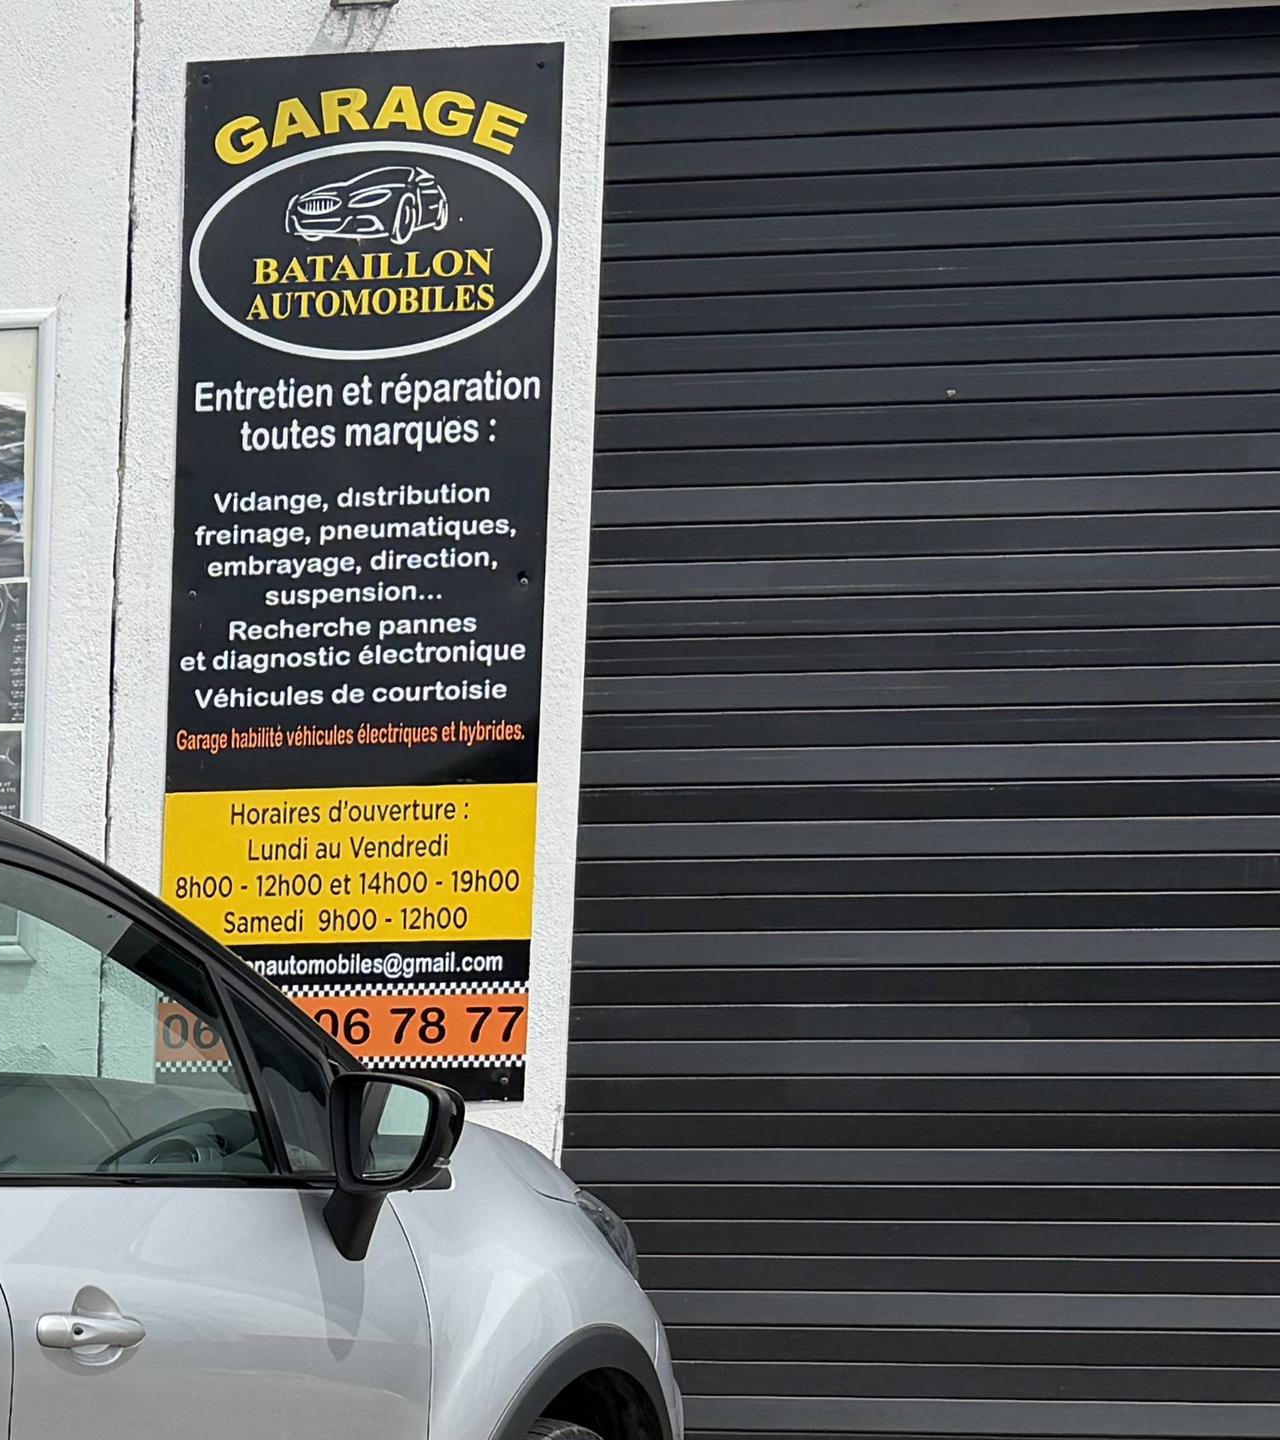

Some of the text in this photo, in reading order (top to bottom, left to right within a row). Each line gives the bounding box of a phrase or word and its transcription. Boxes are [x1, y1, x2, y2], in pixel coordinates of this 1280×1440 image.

[214, 86, 528, 165] GARAGE
[253, 248, 495, 285] BATAILLON
[246, 284, 495, 321] AUTOMOBILES
[195, 370, 541, 412] Entretien et réparation
[240, 419, 336, 451] toutes
[345, 418, 480, 452] marques
[214, 483, 491, 515] Vidange, distribution
[195, 514, 517, 548] freinage, pneumatiques,
[207, 549, 499, 579] embrayage, direction,
[265, 582, 442, 608] suspension...
[228, 615, 477, 641] Recherche pannes
[180, 639, 527, 674] et diagnostic électronique
[194, 679, 508, 709] Véhicules de courtoisie
[176, 719, 526, 755] Garage habilité véhicules électriques et hybrides.
[231, 802, 321, 826] Horaires
[248, 833, 450, 861] Lundi au Vendredi
[175, 874, 233, 900] 8h00
[256, 872, 322, 898] 12h00
[329, 874, 352, 895] et
[359, 870, 427, 895] 14h00
[451, 868, 521, 893] 19h00
[224, 909, 305, 935] Samedi
[318, 908, 377, 932] 9h00
[401, 906, 468, 930] 12h00
[163, 1014, 220, 1049] 06
[390, 1007, 447, 1044] 78
[466, 1006, 525, 1043] 77
